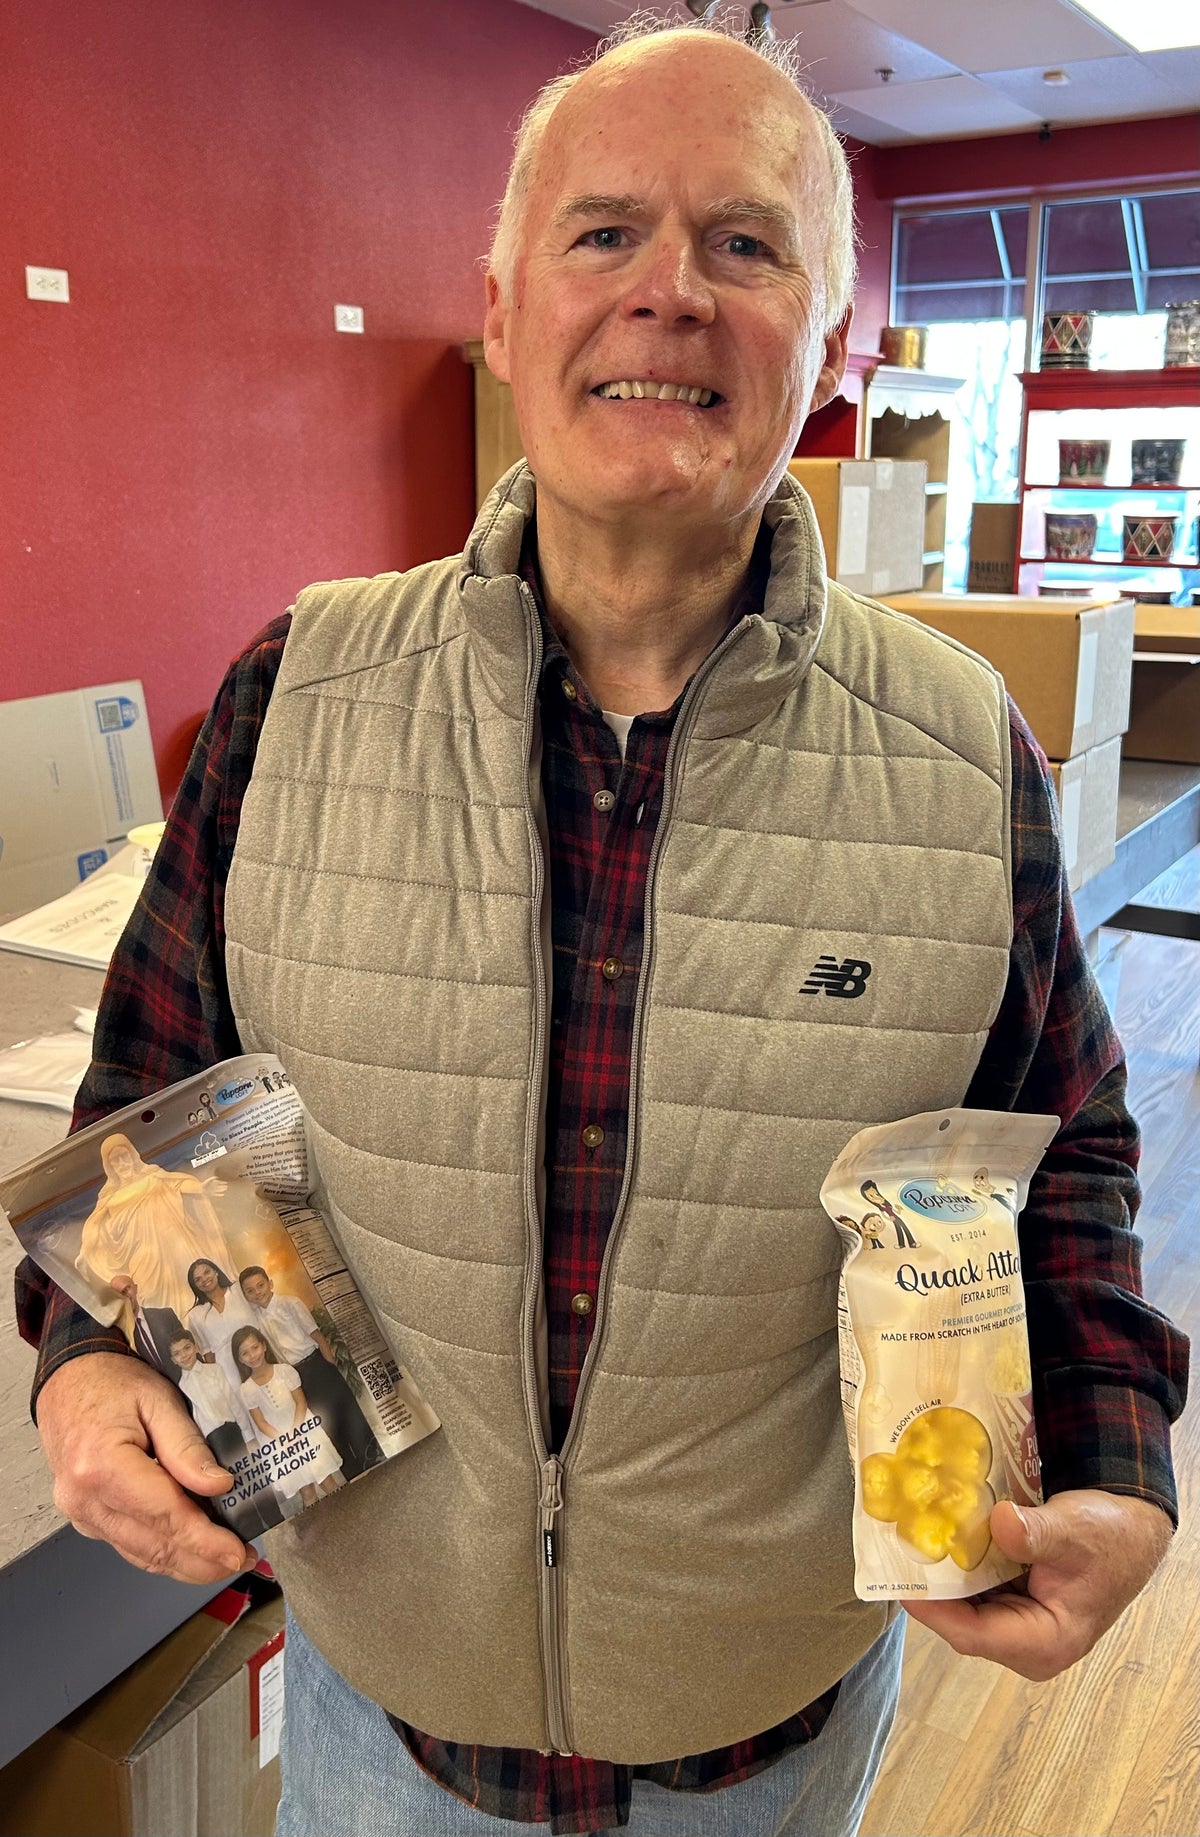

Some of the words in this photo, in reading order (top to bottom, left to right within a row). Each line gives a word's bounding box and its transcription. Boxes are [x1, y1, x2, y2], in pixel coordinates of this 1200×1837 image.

[220, 1081, 254, 1101] Popcorn
[228, 1130, 243, 1139] Bless
[243, 1120, 265, 1133] People.
[249, 1142, 275, 1151] everything
[254, 1160, 277, 1169] blessings
[904, 1189, 977, 1210] Popcorn
[969, 1229, 987, 1240] 2014
[895, 1258, 983, 1296] Quack
[960, 1289, 985, 1306] (EXTRA
[986, 1284, 1011, 1299] BUTTER)
[942, 1313, 974, 1327] PREMIER
[974, 1308, 1003, 1322] GOURMET
[880, 1333, 908, 1342] MADE
[909, 1331, 936, 1341] FROM
[937, 1327, 972, 1340] SCRATCH
[972, 1325, 980, 1334] IN
[980, 1323, 991, 1333] THE
[992, 1318, 1008, 1330] HEART
[1008, 1316, 1015, 1326] OF
[890, 1431, 900, 1444] WE
[896, 1410, 916, 1431] DON'T
[914, 1402, 930, 1414] SELL
[930, 1398, 942, 1407] AIR
[228, 1456, 250, 1475] ARE
[251, 1439, 278, 1463] NOT
[278, 1415, 323, 1447] PLACED
[244, 1459, 272, 1480] THIS
[272, 1437, 310, 1466] EARTH
[221, 1496, 237, 1511] TO
[238, 1473, 275, 1501] WALK
